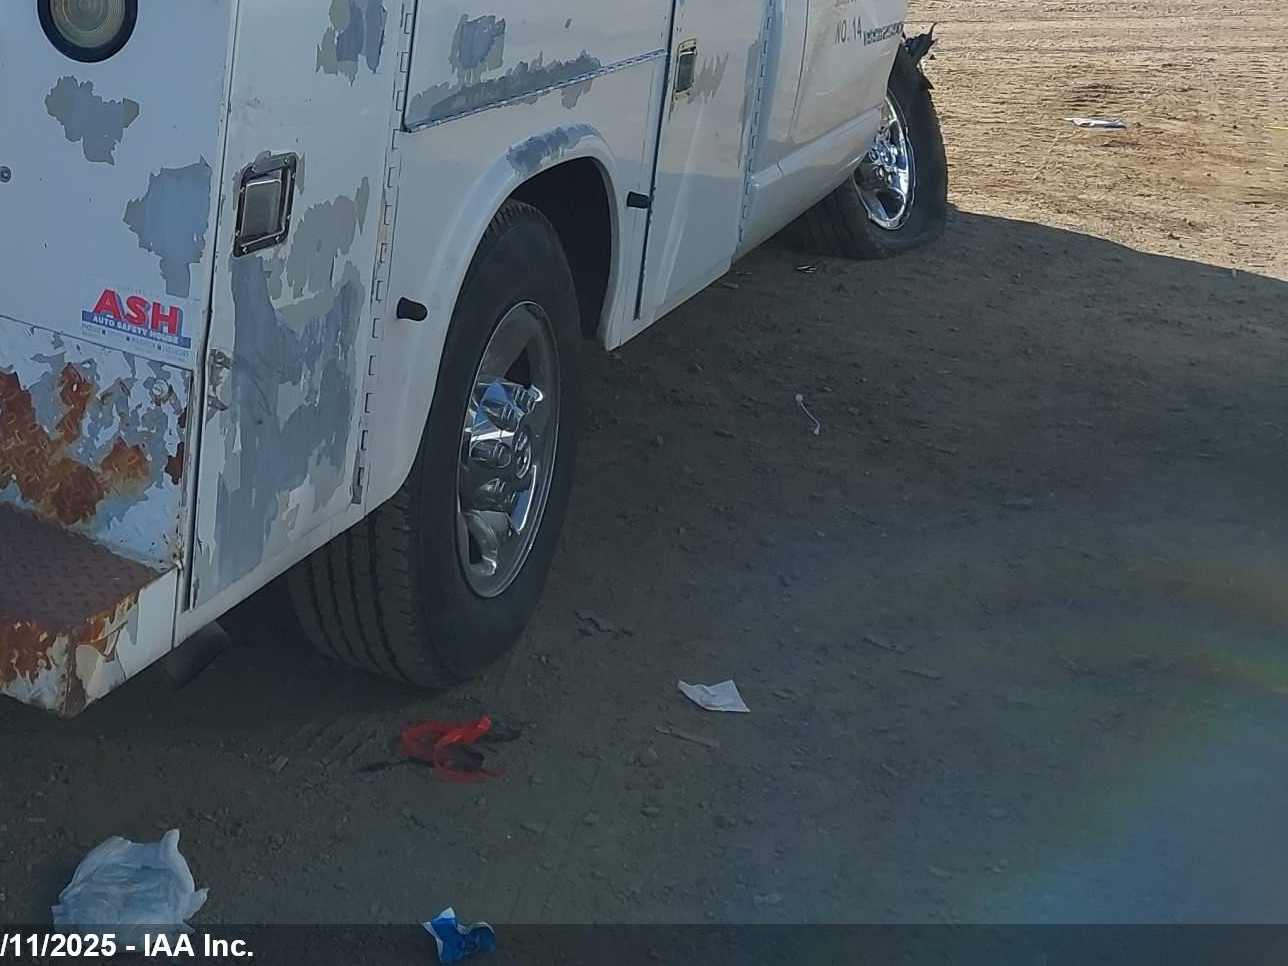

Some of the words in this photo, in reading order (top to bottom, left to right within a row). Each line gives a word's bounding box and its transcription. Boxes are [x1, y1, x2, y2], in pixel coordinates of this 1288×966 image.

[853, 17, 862, 40] 14
[93, 289, 182, 336] ASH
[92, 315, 115, 328] AUTO
[116, 321, 148, 337] SAFETY
[149, 329, 180, 344] HOUSE
